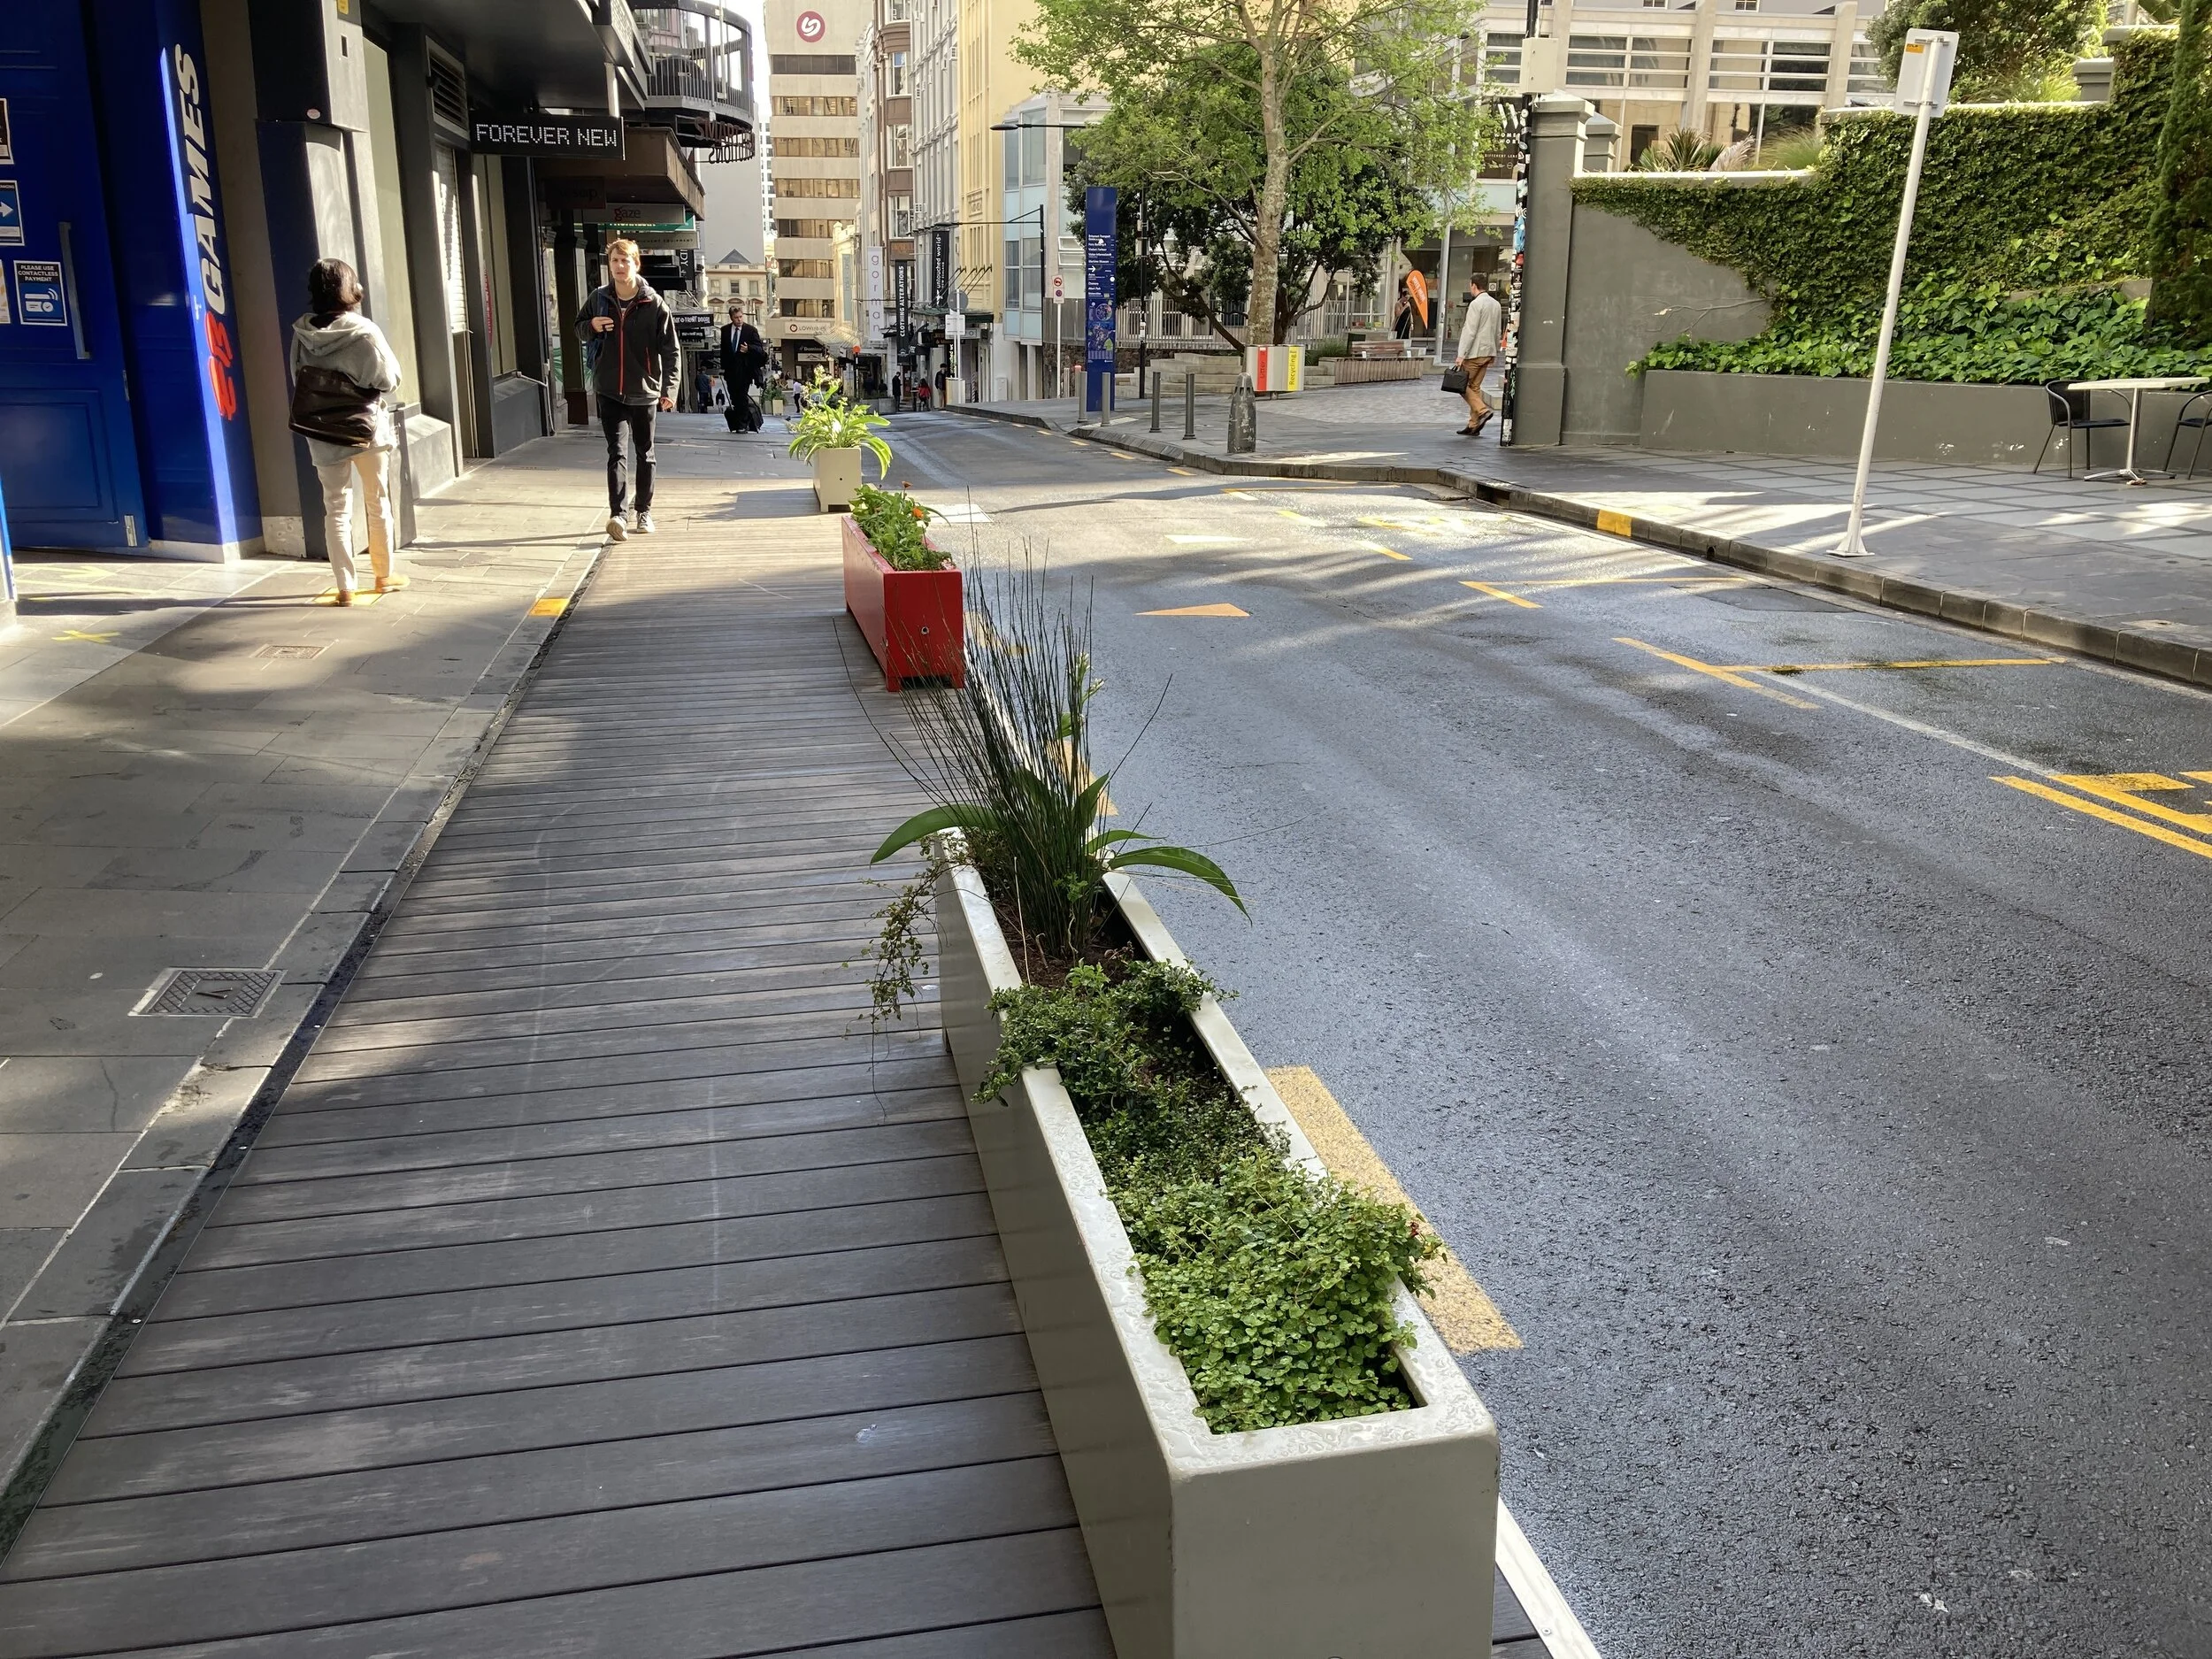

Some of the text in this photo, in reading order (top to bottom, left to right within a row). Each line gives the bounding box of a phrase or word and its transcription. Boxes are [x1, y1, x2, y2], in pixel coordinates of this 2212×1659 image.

[476, 124, 617, 147] FOREVER NEW
[174, 43, 226, 316] GAMES
[613, 205, 641, 221] gaze
[871, 255, 881, 332] gorman
